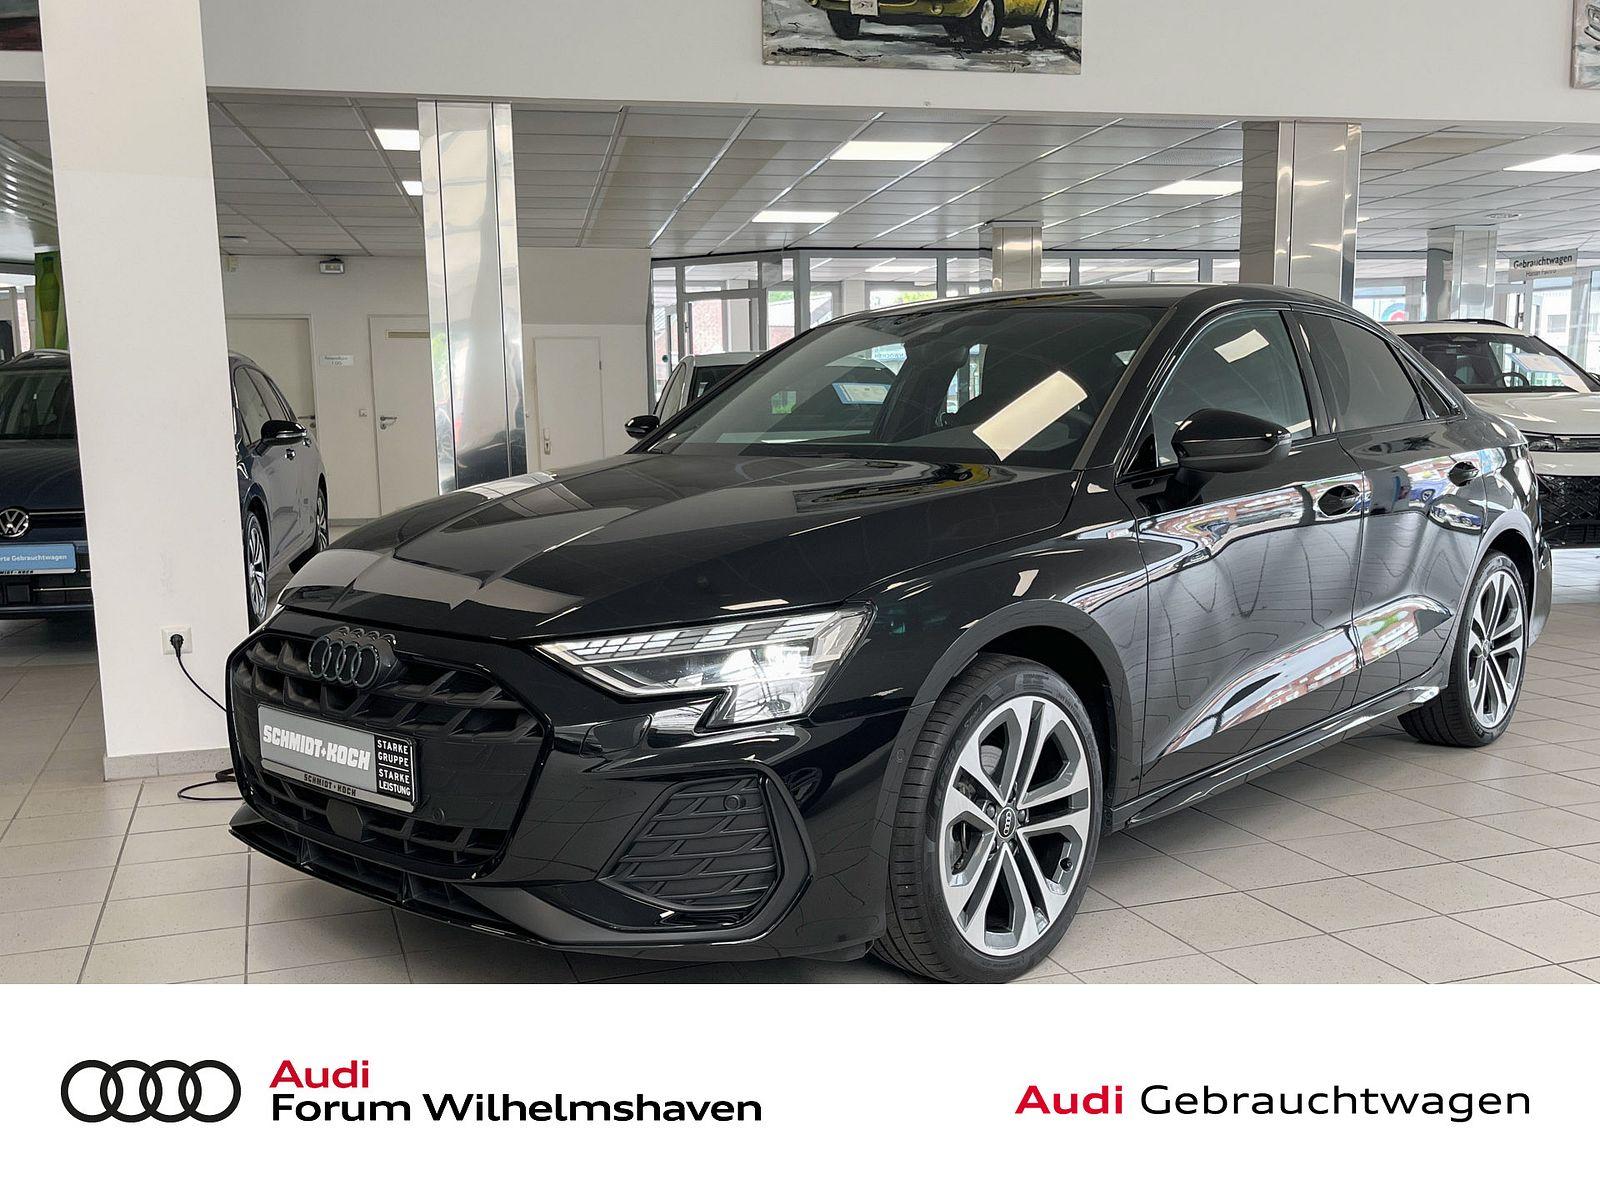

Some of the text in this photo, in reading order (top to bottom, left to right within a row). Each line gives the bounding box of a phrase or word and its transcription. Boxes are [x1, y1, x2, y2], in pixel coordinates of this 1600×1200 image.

[1513, 254, 1573, 269] Gebrauchtwagen
[11, 554, 68, 562] Gebrauchtwagen
[377, 739, 409, 755] STARKE
[377, 751, 410, 767] GRUPPE
[378, 768, 410, 784] STARKE
[378, 780, 411, 797] LEISTUNG
